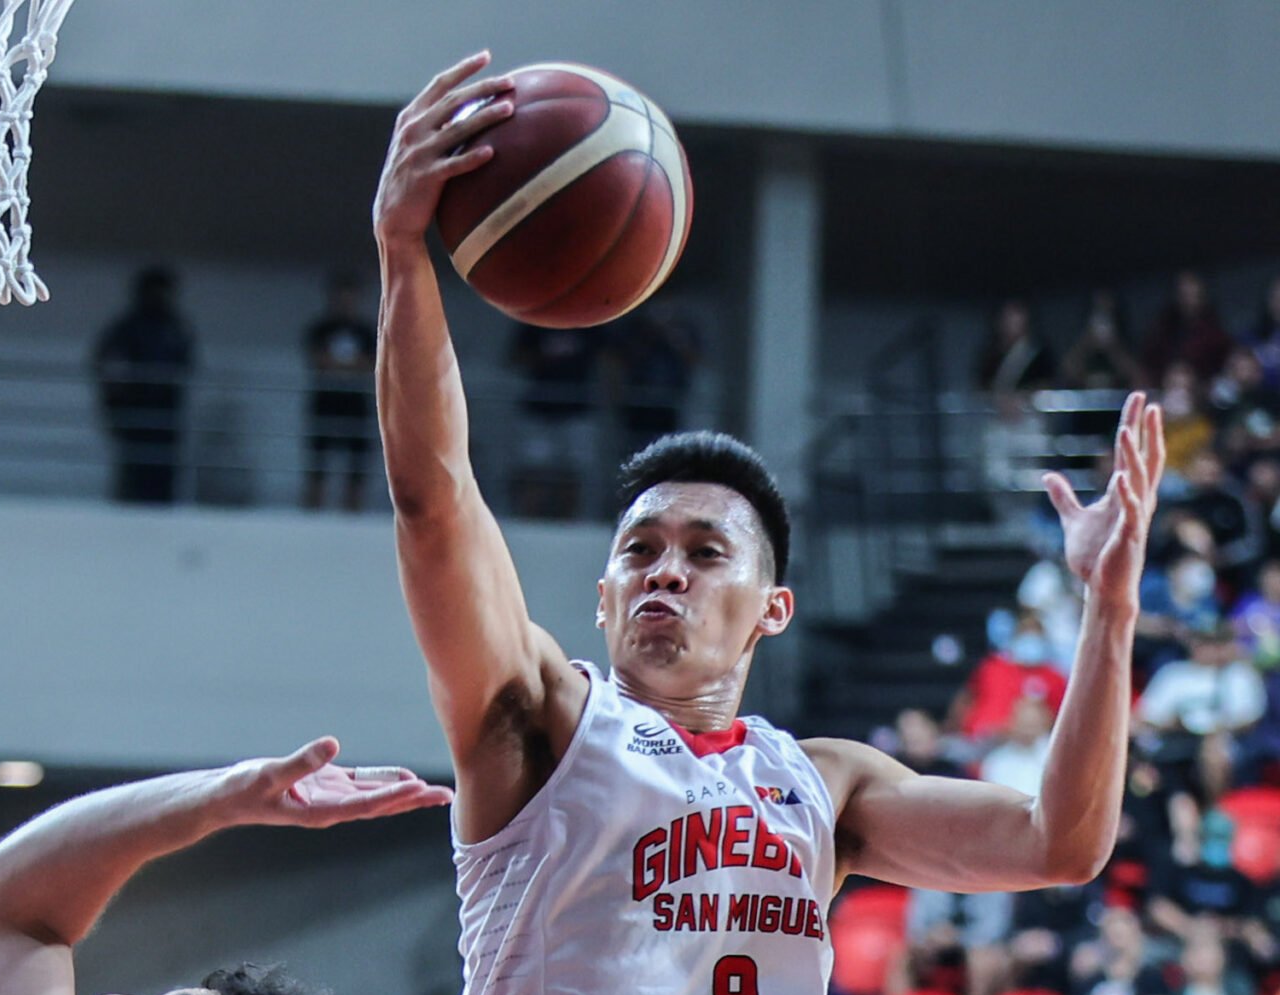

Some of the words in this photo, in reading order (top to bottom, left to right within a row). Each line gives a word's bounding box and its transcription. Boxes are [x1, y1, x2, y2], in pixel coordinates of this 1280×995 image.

[632, 736, 677, 747] WORLD
[627, 745, 683, 756] BALANCE
[653, 893, 719, 932] SAN
[726, 893, 824, 941] MIGUE
